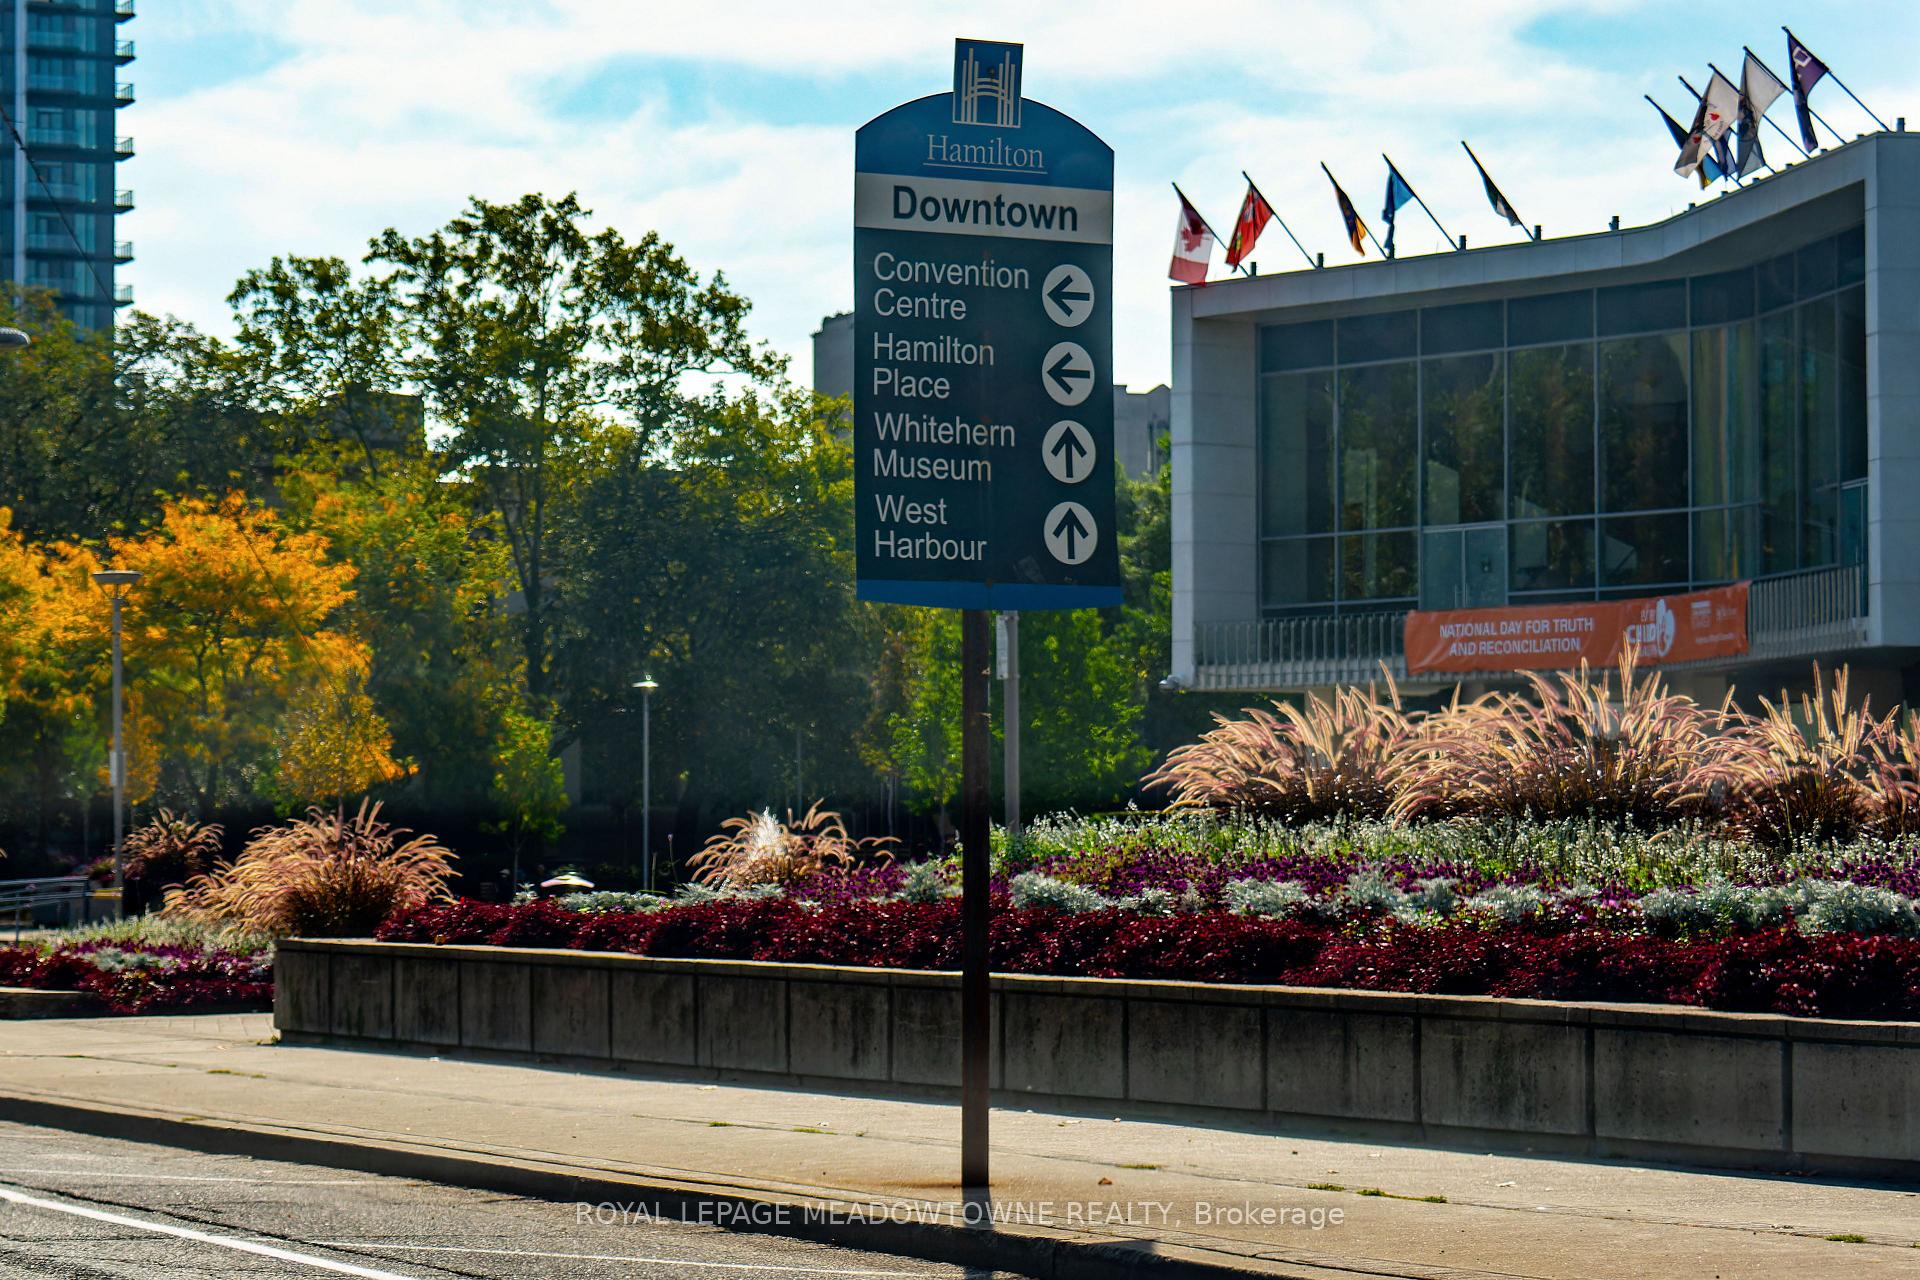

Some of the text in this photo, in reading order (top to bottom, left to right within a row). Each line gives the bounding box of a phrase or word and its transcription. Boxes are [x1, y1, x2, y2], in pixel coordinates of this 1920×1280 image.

[927, 134, 1044, 168] Hamilton
[893, 185, 1078, 231] Downtown
[874, 252, 1029, 289] Convention
[874, 288, 967, 320] Centre
[873, 332, 994, 366] Hamilton
[873, 367, 950, 399] Place
[874, 412, 1016, 447] Whitehern
[873, 448, 991, 482] Museum
[875, 494, 947, 525] West
[874, 530, 987, 560] Harbour
[1439, 617, 1594, 638] NATIONAL DAY FOR TRUTH
[1449, 637, 1580, 656] AND RECONCILIATION
